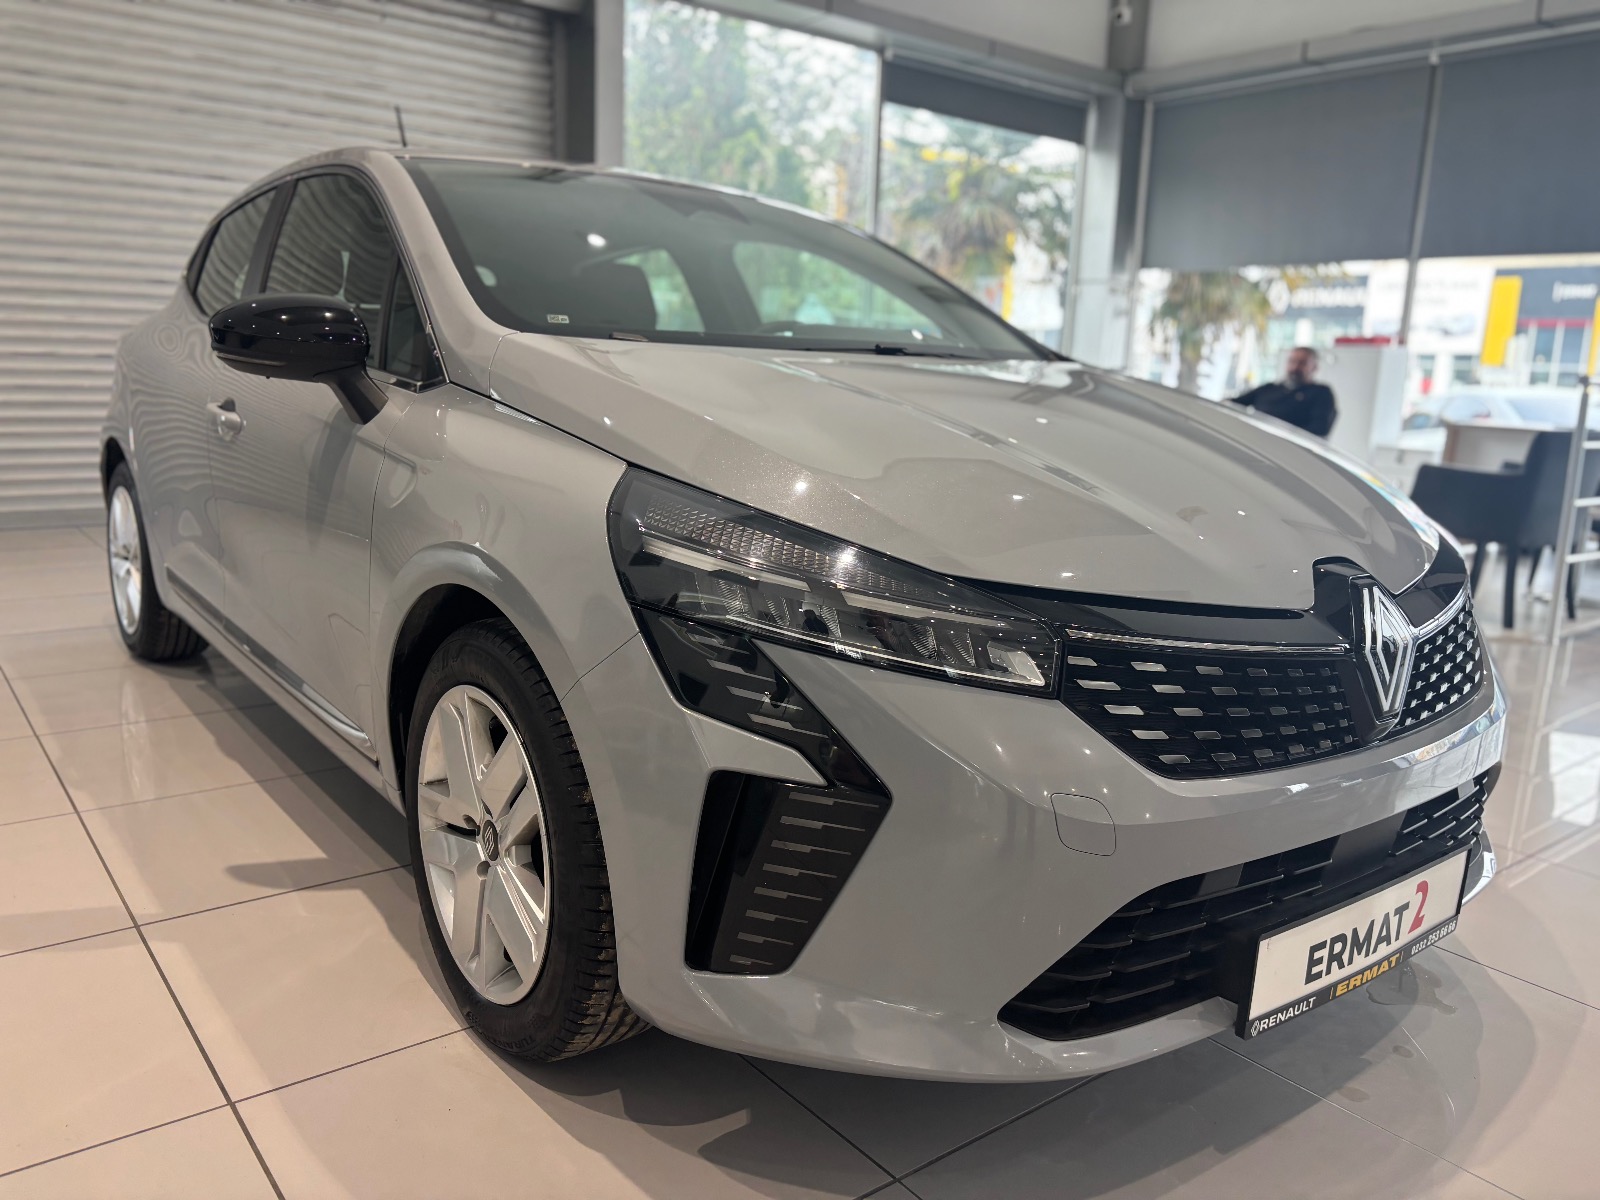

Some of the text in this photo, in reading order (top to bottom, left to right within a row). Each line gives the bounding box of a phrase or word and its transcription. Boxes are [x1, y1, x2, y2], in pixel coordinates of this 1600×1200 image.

[1304, 900, 1410, 986] ERMAT
[1259, 996, 1317, 1032] RENAULT
[1335, 953, 1401, 997] ERMAT
